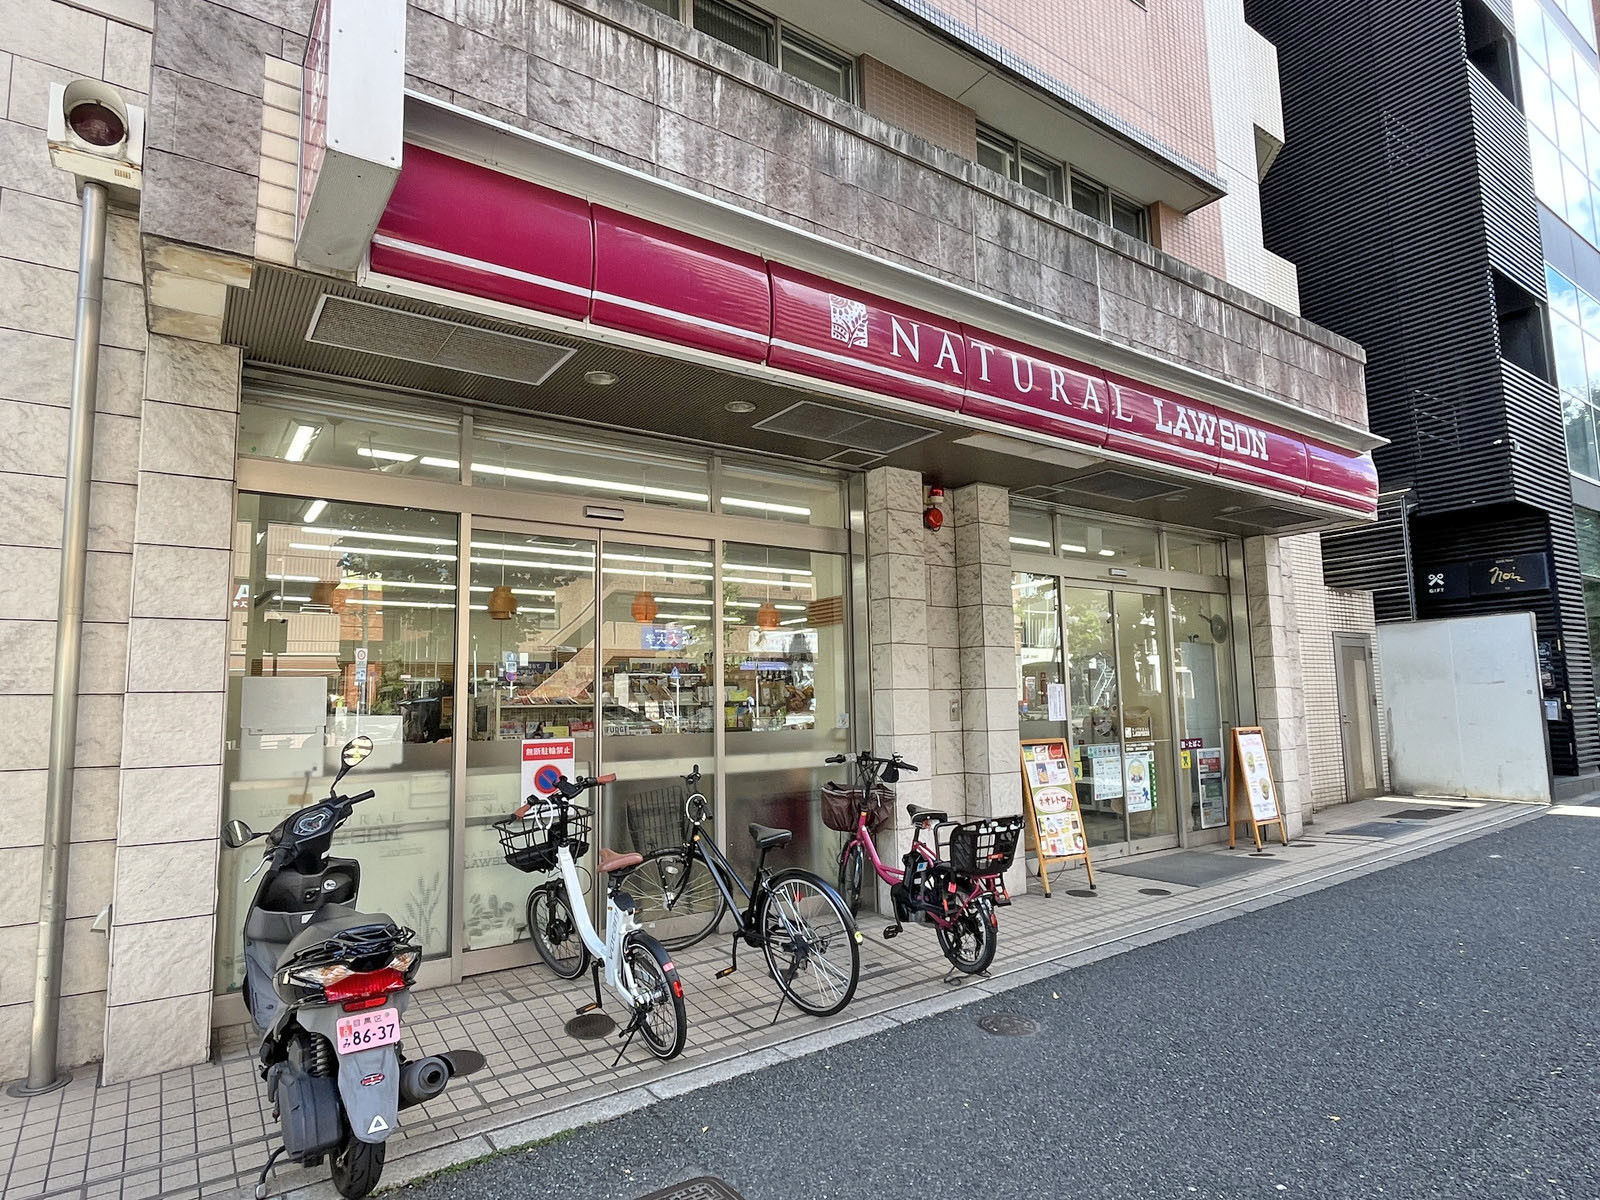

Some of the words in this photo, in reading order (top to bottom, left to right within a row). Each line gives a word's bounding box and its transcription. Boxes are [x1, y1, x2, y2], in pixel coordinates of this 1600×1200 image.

[890, 317, 1133, 423] NATURAL
[1153, 399, 1269, 461] LAWSON
[525, 745, 571, 757] 無断駐輪禁止
[342, 1038, 351, 1048] み
[352, 1023, 395, 1046] 86-37
